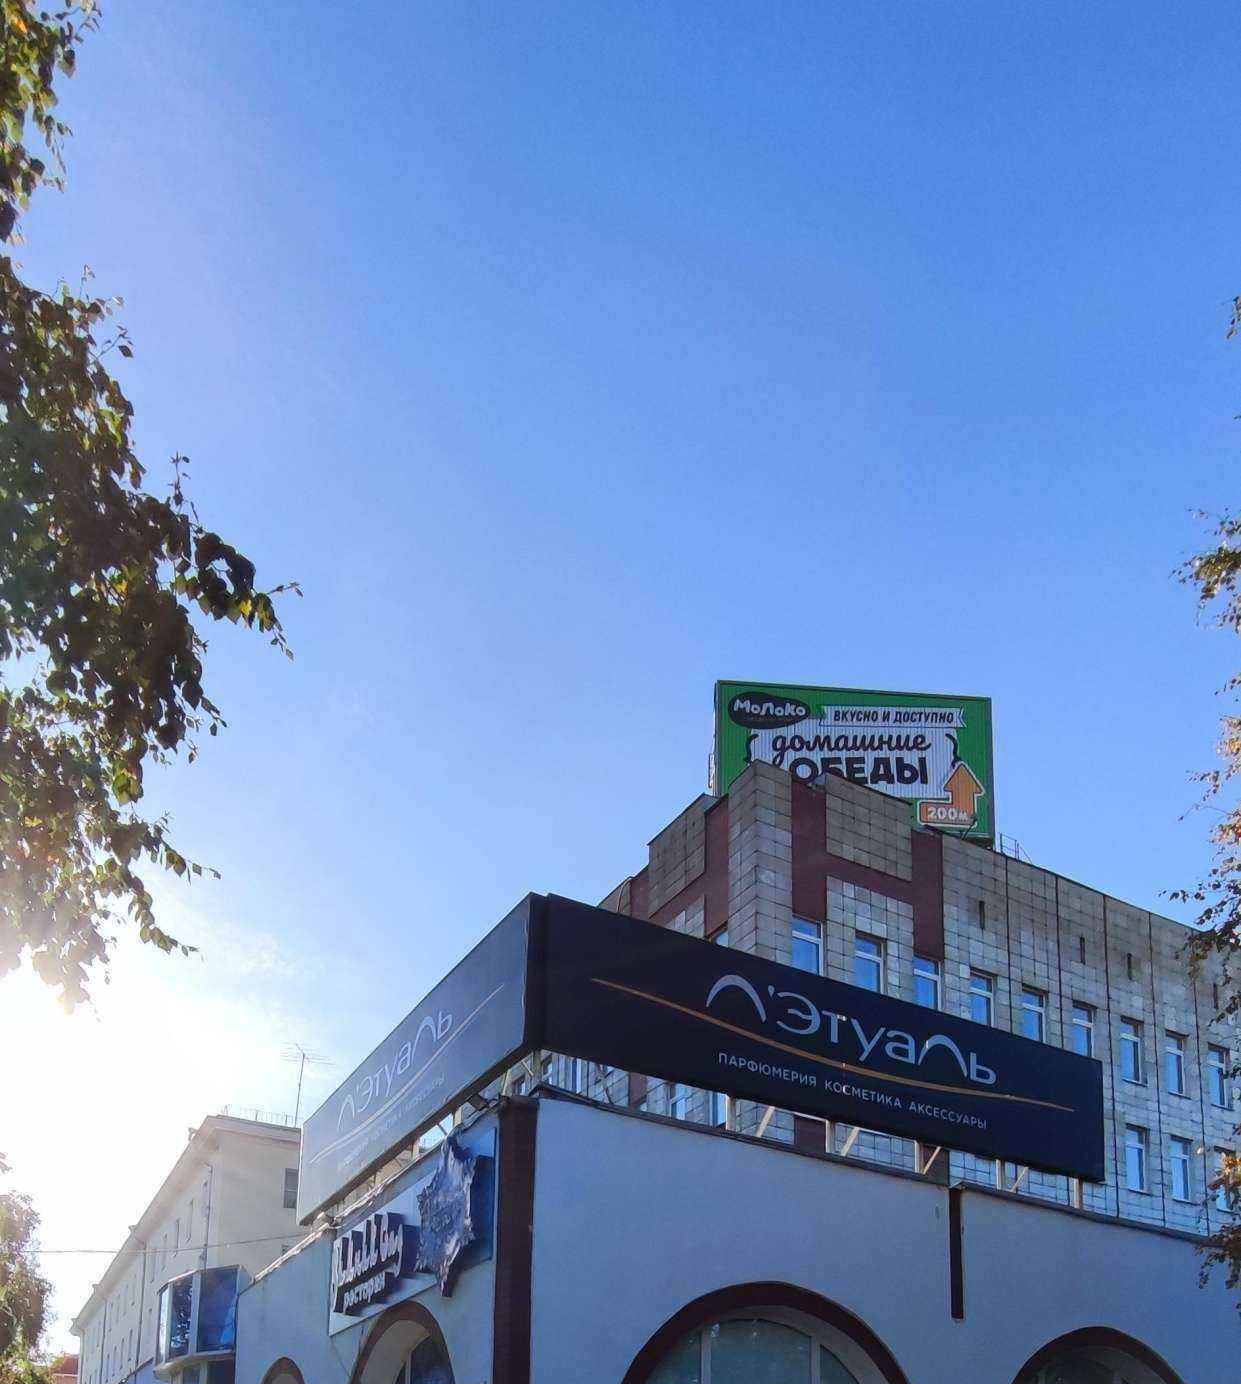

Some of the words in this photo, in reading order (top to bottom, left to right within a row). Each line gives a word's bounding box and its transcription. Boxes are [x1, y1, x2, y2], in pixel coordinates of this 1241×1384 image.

[833, 709, 879, 724] ВКУСНО
[881, 711, 889, 724] И
[892, 711, 954, 725] ДОСТУПНО
[772, 733, 932, 767] домашние
[789, 757, 929, 785] ОБЕДЫ
[718, 1052, 817, 1087] ПАРФЮМЕРИЯ
[824, 1080, 902, 1109] КОСМЕТИКА
[909, 1101, 988, 1130] АКСЕССУАРЫ
[343, 1272, 386, 1313] ресторан
